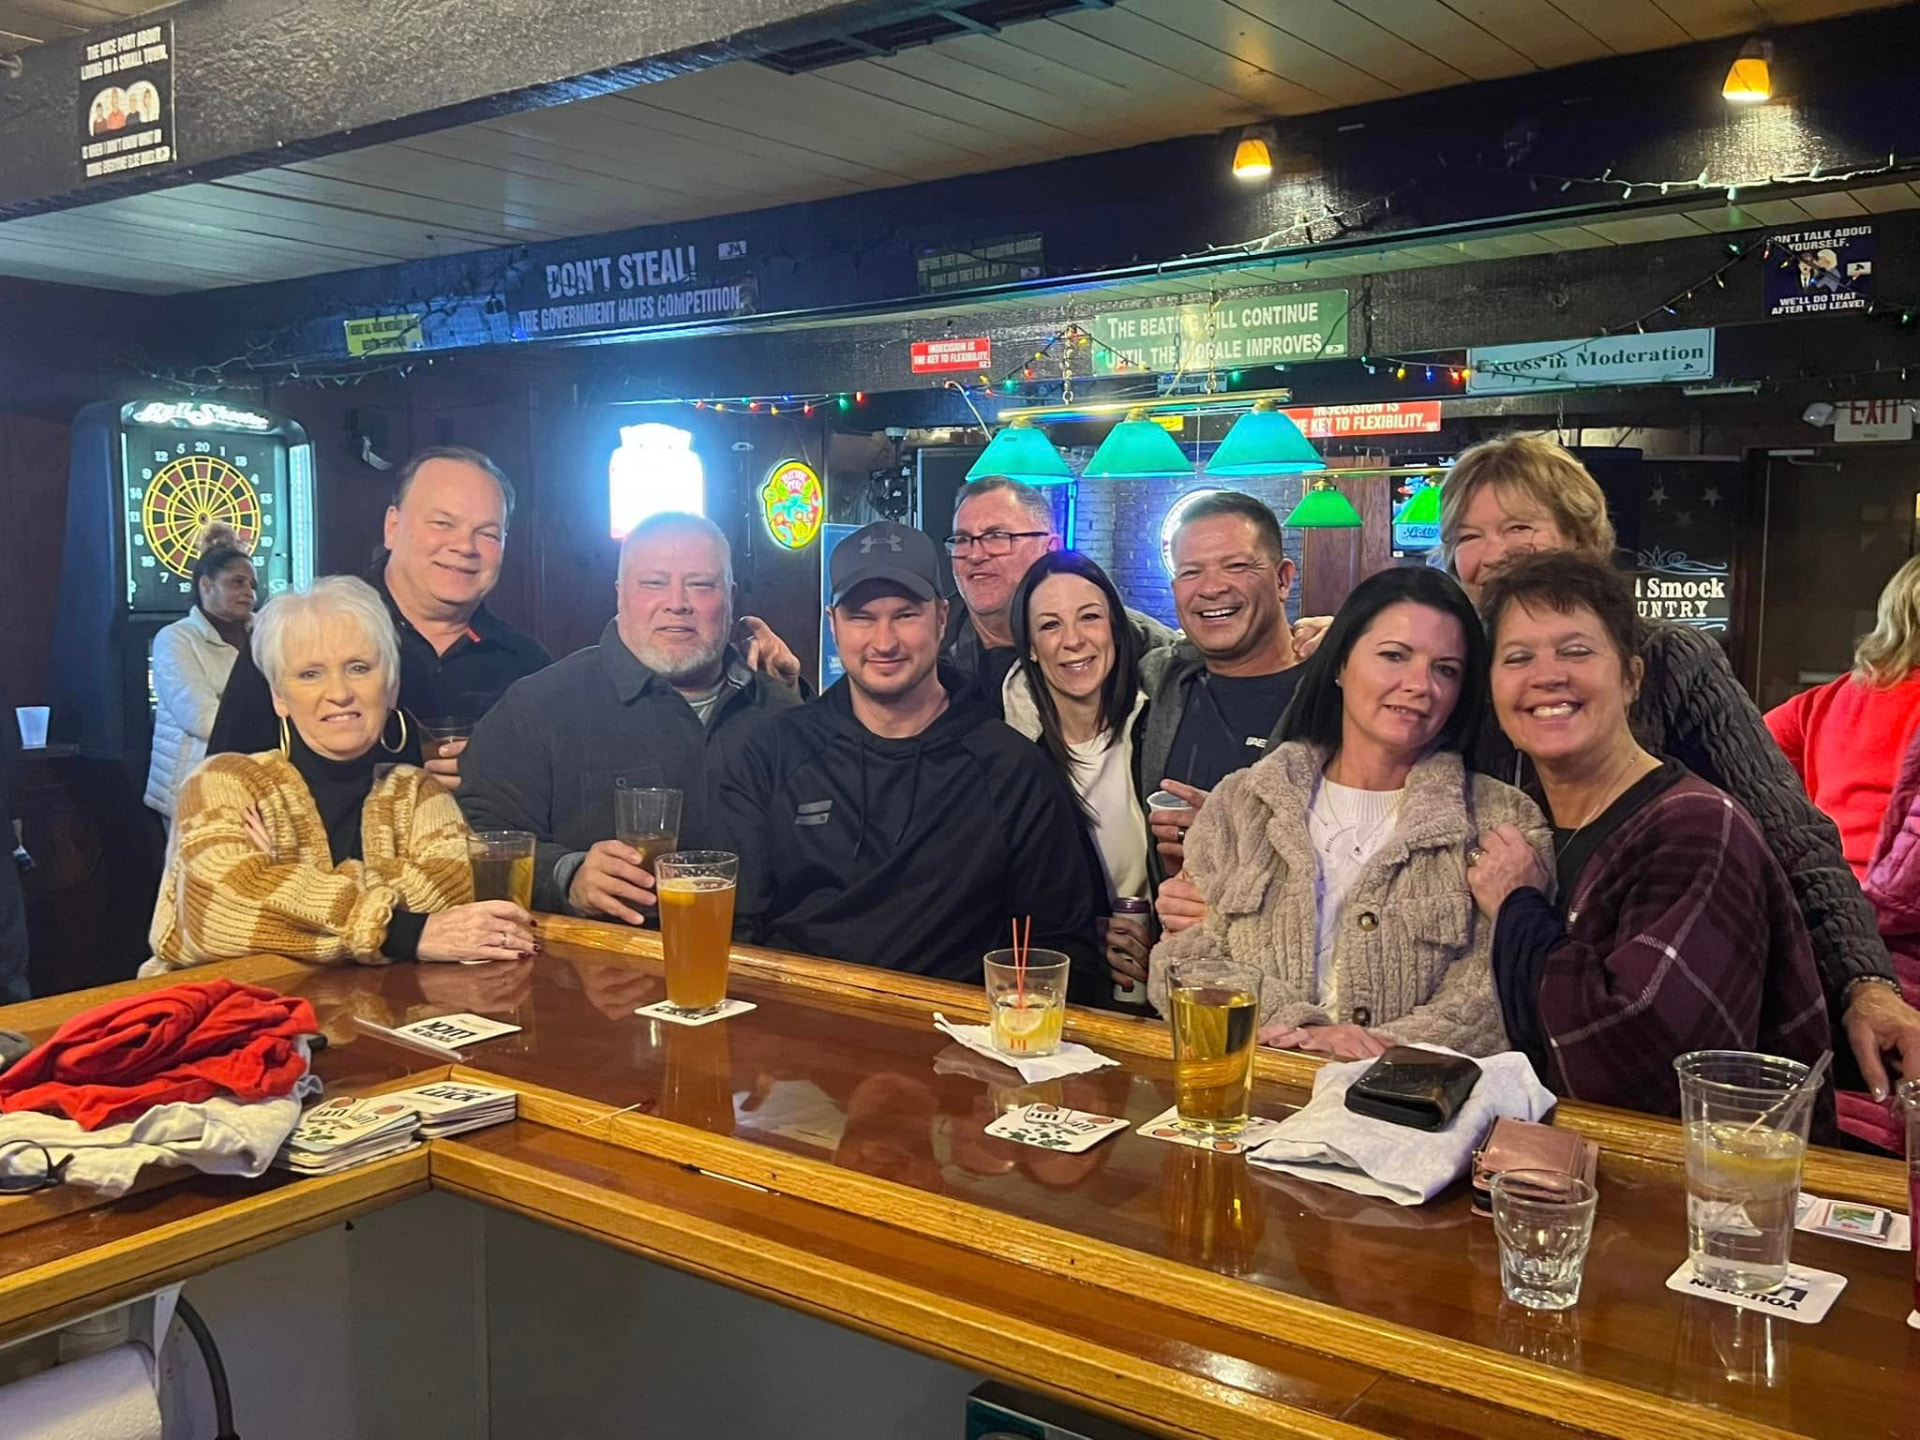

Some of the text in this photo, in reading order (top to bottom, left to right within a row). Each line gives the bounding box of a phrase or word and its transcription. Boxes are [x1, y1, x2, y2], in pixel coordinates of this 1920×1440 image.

[1803, 229, 1831, 241] TALK
[1834, 225, 1872, 237] ABOUT
[1788, 238, 1850, 252] YOURSELF.
[546, 257, 611, 299] DON'T
[618, 245, 696, 290] STEAL!
[1779, 292, 1856, 306] WE'LL DO THAT
[518, 286, 745, 332] THE GOVERNMENT HATES COMPETITION.
[1771, 305, 1803, 315] AFTER
[1806, 302, 1827, 312] YOU
[1107, 317, 1135, 340] THE
[1242, 302, 1318, 328] CONTINUE
[928, 341, 975, 354] INDECISION IS
[1151, 346, 1177, 366] THE
[1246, 333, 1322, 357] IMPROVES
[914, 355, 926, 365] THE
[926, 354, 940, 364] KEY
[940, 353, 949, 363] TO
[1575, 347, 1704, 367] Moderation
[1850, 401, 1897, 425] EXIT
[1293, 418, 1308, 434] HE
[1310, 417, 1332, 433] KEY
[1335, 417, 1349, 431] TO
[1353, 413, 1426, 430] FLEXIBILITY.
[176, 443, 185, 454] 5
[195, 442, 210, 453] 20
[219, 446, 226, 456] 1
[155, 451, 169, 462] 12
[142, 468, 152, 479] 9
[251, 474, 259, 484] 4
[130, 511, 141, 522] 11
[159, 572, 169, 583] 7
[178, 582, 191, 593] 19
[1647, 577, 1725, 598] Smock
[1637, 600, 1708, 617] UNTRY
[419, 1021, 478, 1039] LUCK
[1715, 1286, 1798, 1311] YOU'
